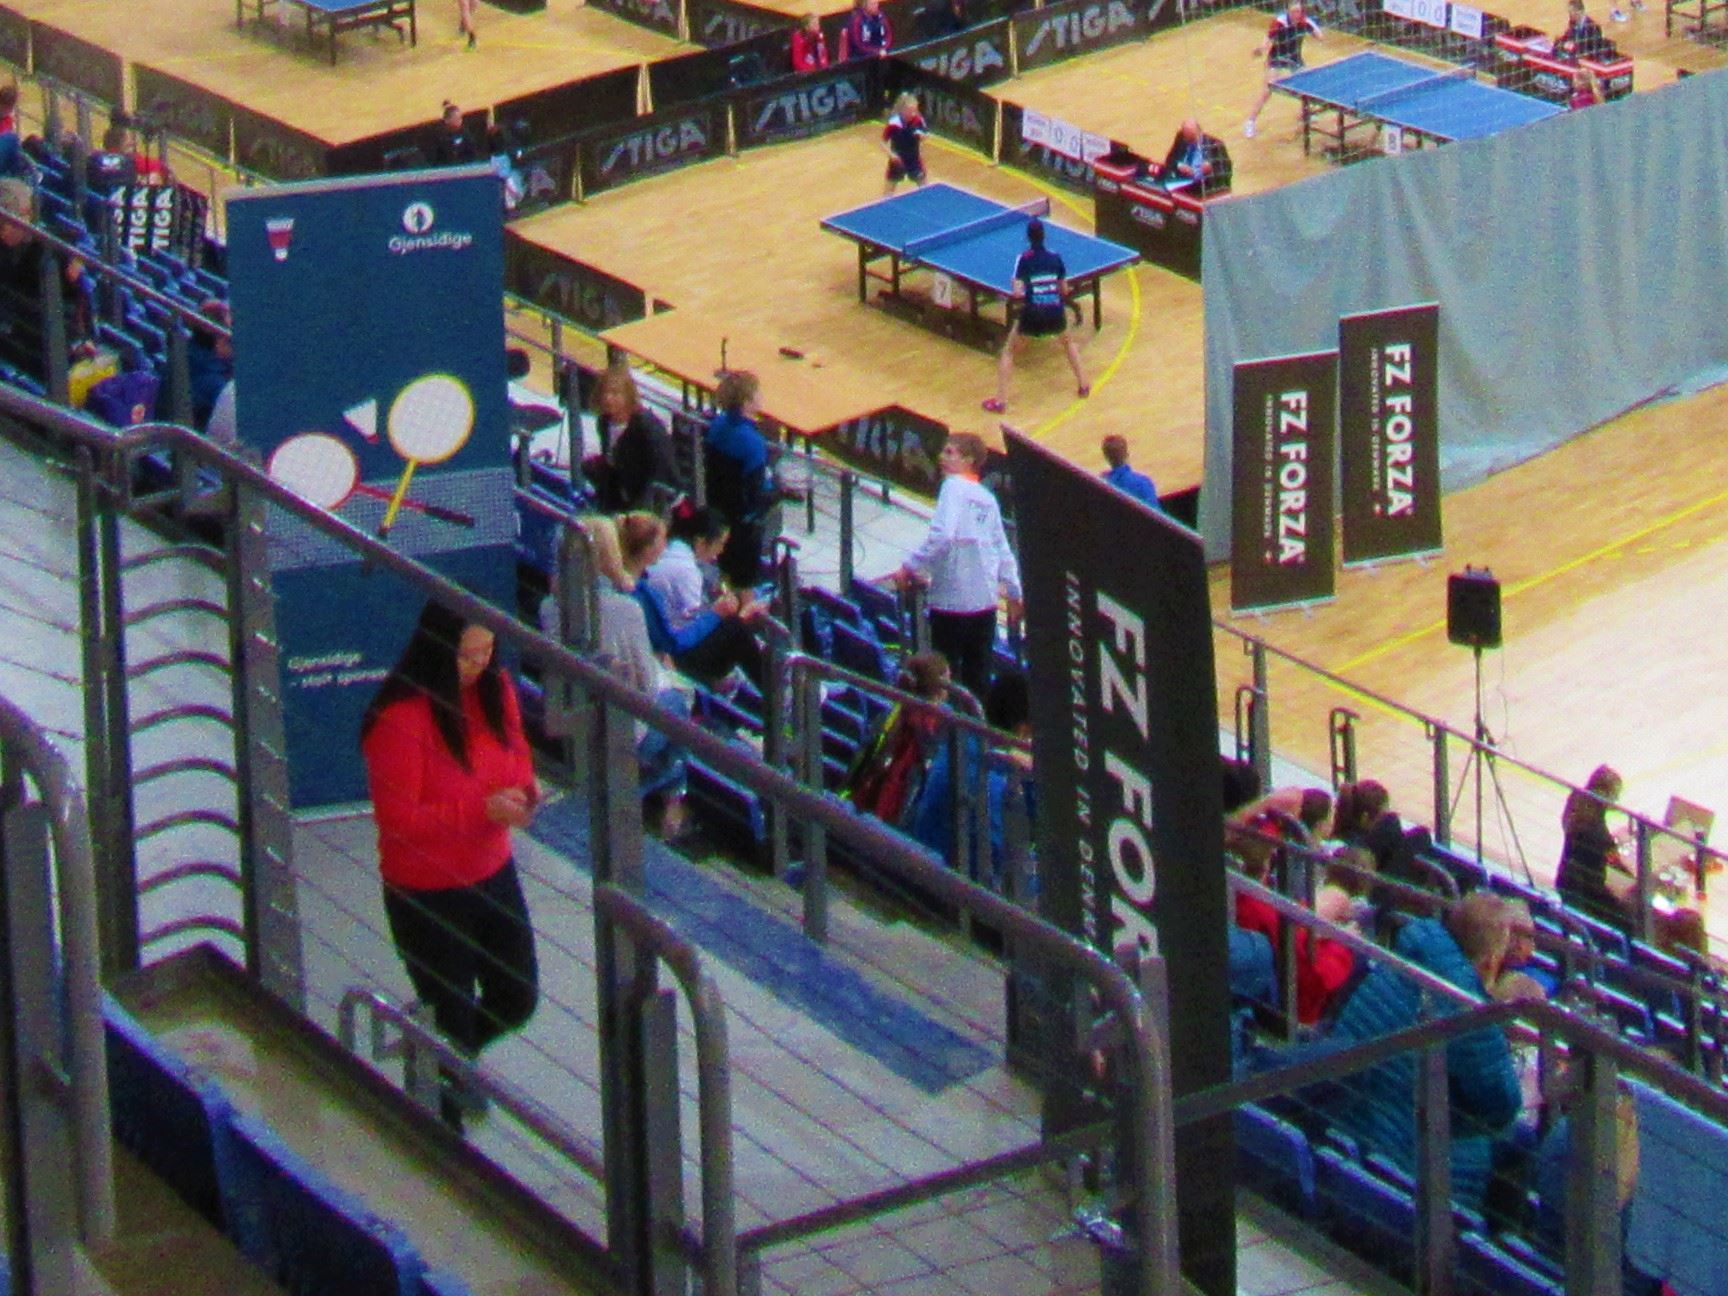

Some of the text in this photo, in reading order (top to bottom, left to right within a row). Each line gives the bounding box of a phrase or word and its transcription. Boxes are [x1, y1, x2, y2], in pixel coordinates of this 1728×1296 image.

[1026, 0, 1136, 57] STIGA
[602, 120, 707, 175] STIGA
[754, 79, 864, 135] STIGA
[388, 232, 473, 255] Gjensidige
[1279, 390, 1308, 564] FZ FORZA
[1385, 342, 1414, 516] FZ FORZA
[1065, 569, 1097, 940] INNOVATED IN DENM
[1096, 589, 1161, 961] FZ FOR
